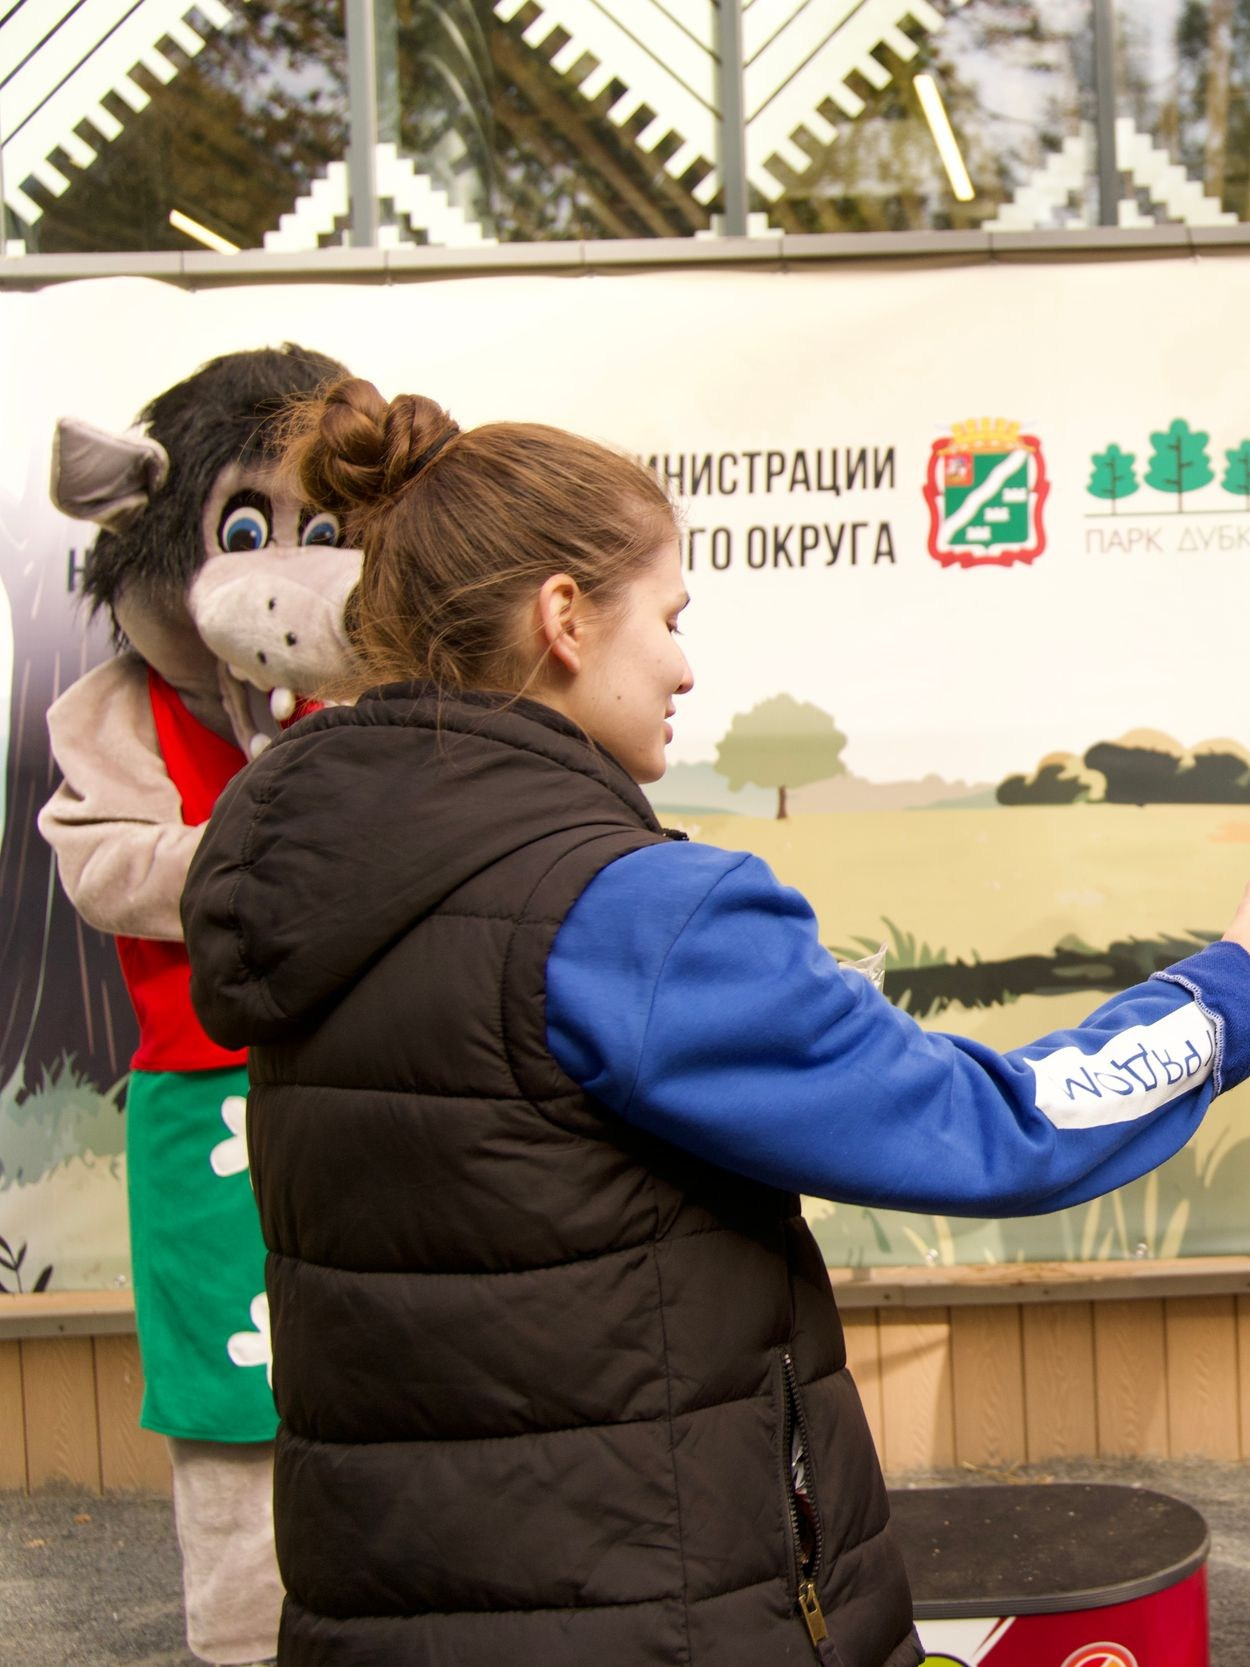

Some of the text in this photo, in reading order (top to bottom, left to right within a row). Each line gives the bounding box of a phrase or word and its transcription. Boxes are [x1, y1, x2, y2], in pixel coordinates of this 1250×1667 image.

[645, 447, 896, 497] НИСТРАЦИИ
[747, 522, 897, 569] ОКРУГА
[1084, 526, 1166, 555] ПАРК
